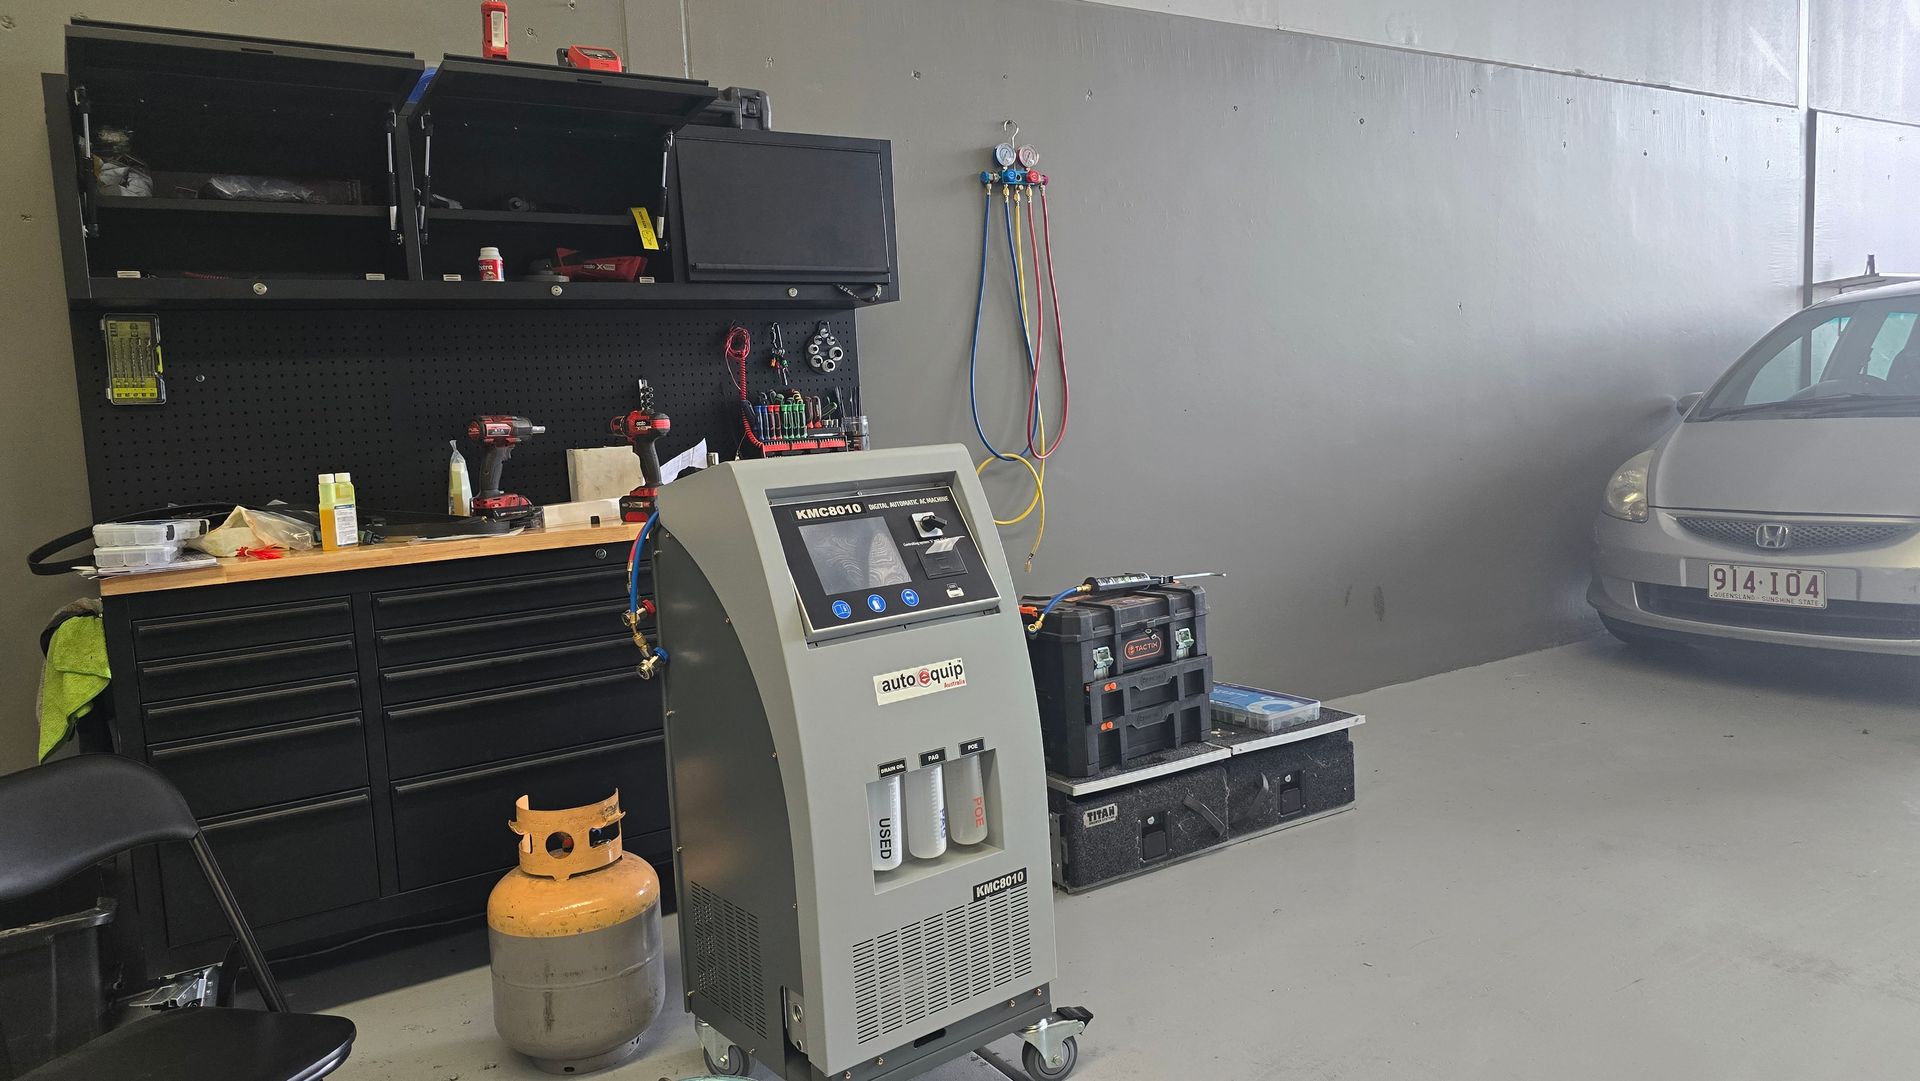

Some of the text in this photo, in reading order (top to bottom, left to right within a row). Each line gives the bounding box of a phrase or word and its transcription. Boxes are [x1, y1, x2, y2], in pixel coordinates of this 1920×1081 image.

[868, 502, 890, 511] DIGITAL
[889, 499, 919, 508] AUTOMATIC
[926, 495, 950, 504] MACHINE
[795, 503, 862, 520] KMC8010
[1713, 591, 1818, 607] QUEENSLAND SUNSHINE STATE
[1134, 642, 1158, 652] TACTIX
[944, 679, 966, 689] Australia
[927, 753, 939, 761] PAG
[880, 765, 896, 774] DRAIN
[974, 796, 985, 828] POE
[1087, 805, 1115, 822] TITAN
[879, 817, 892, 860] USED
[976, 871, 1024, 898] KMC8010
